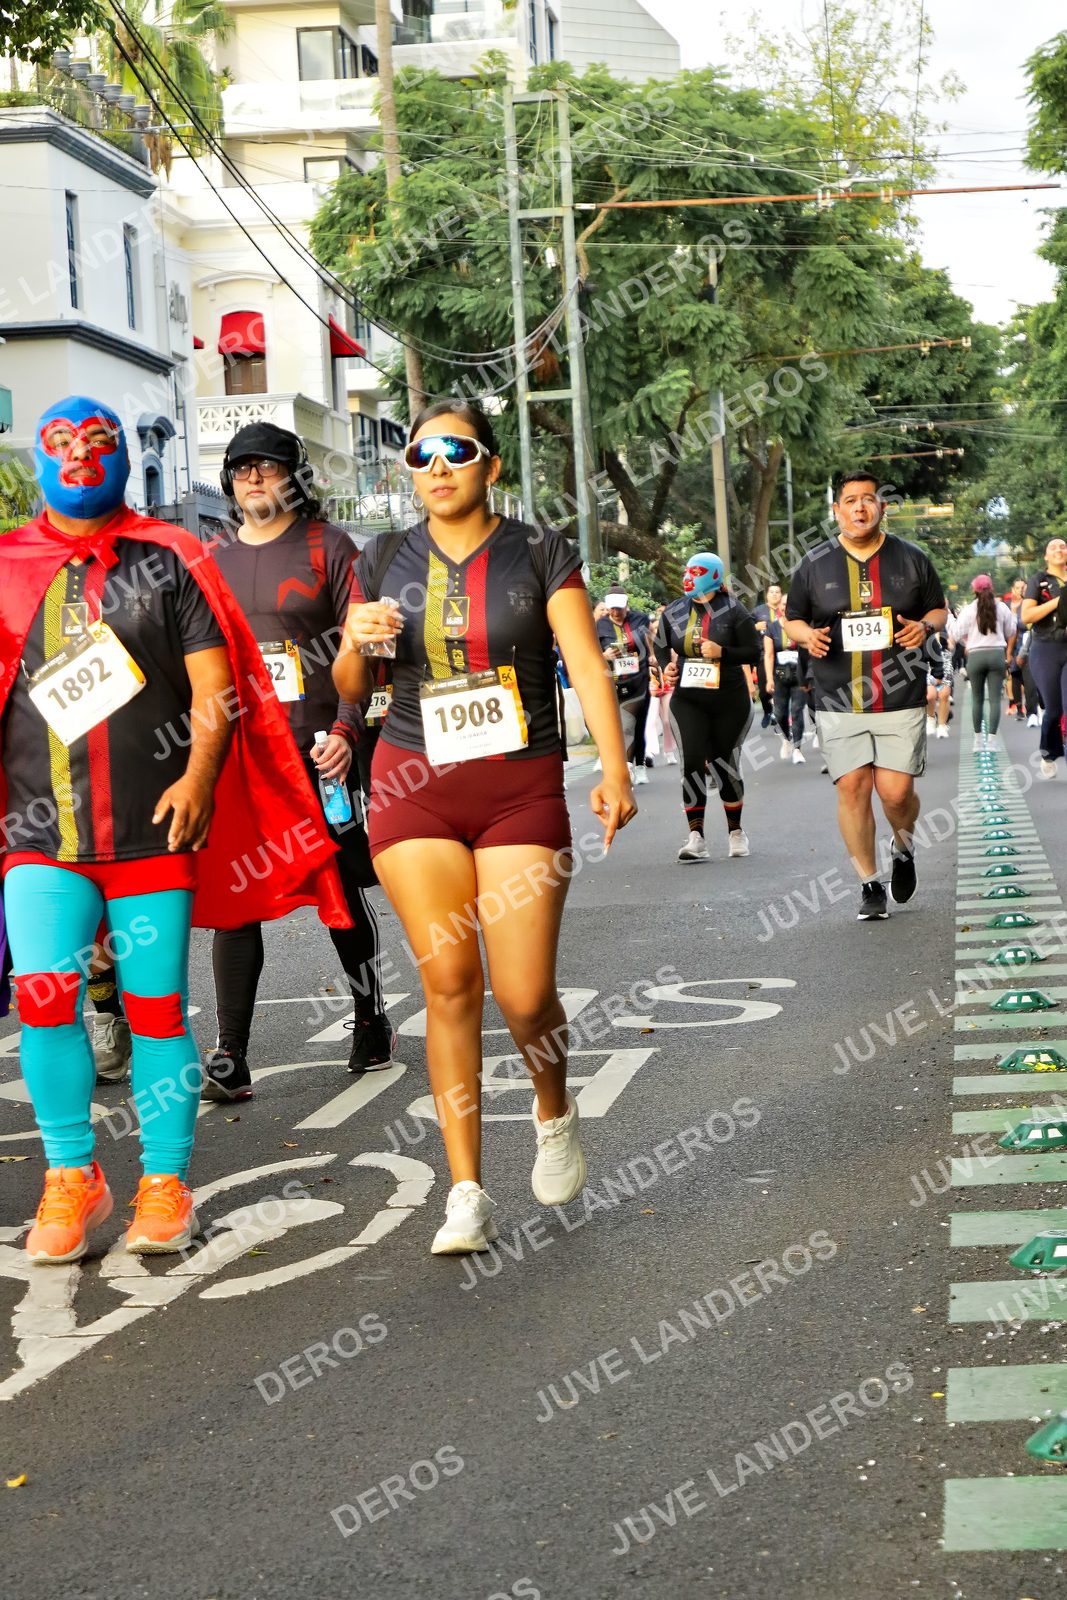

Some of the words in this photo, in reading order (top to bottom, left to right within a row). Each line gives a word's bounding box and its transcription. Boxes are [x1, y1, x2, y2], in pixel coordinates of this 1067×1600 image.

[847, 621, 882, 637] 1934
[687, 666, 712, 678] 5277
[47, 656, 113, 710] 1892
[370, 695, 387, 707] 78
[434, 697, 503, 733] 1908
